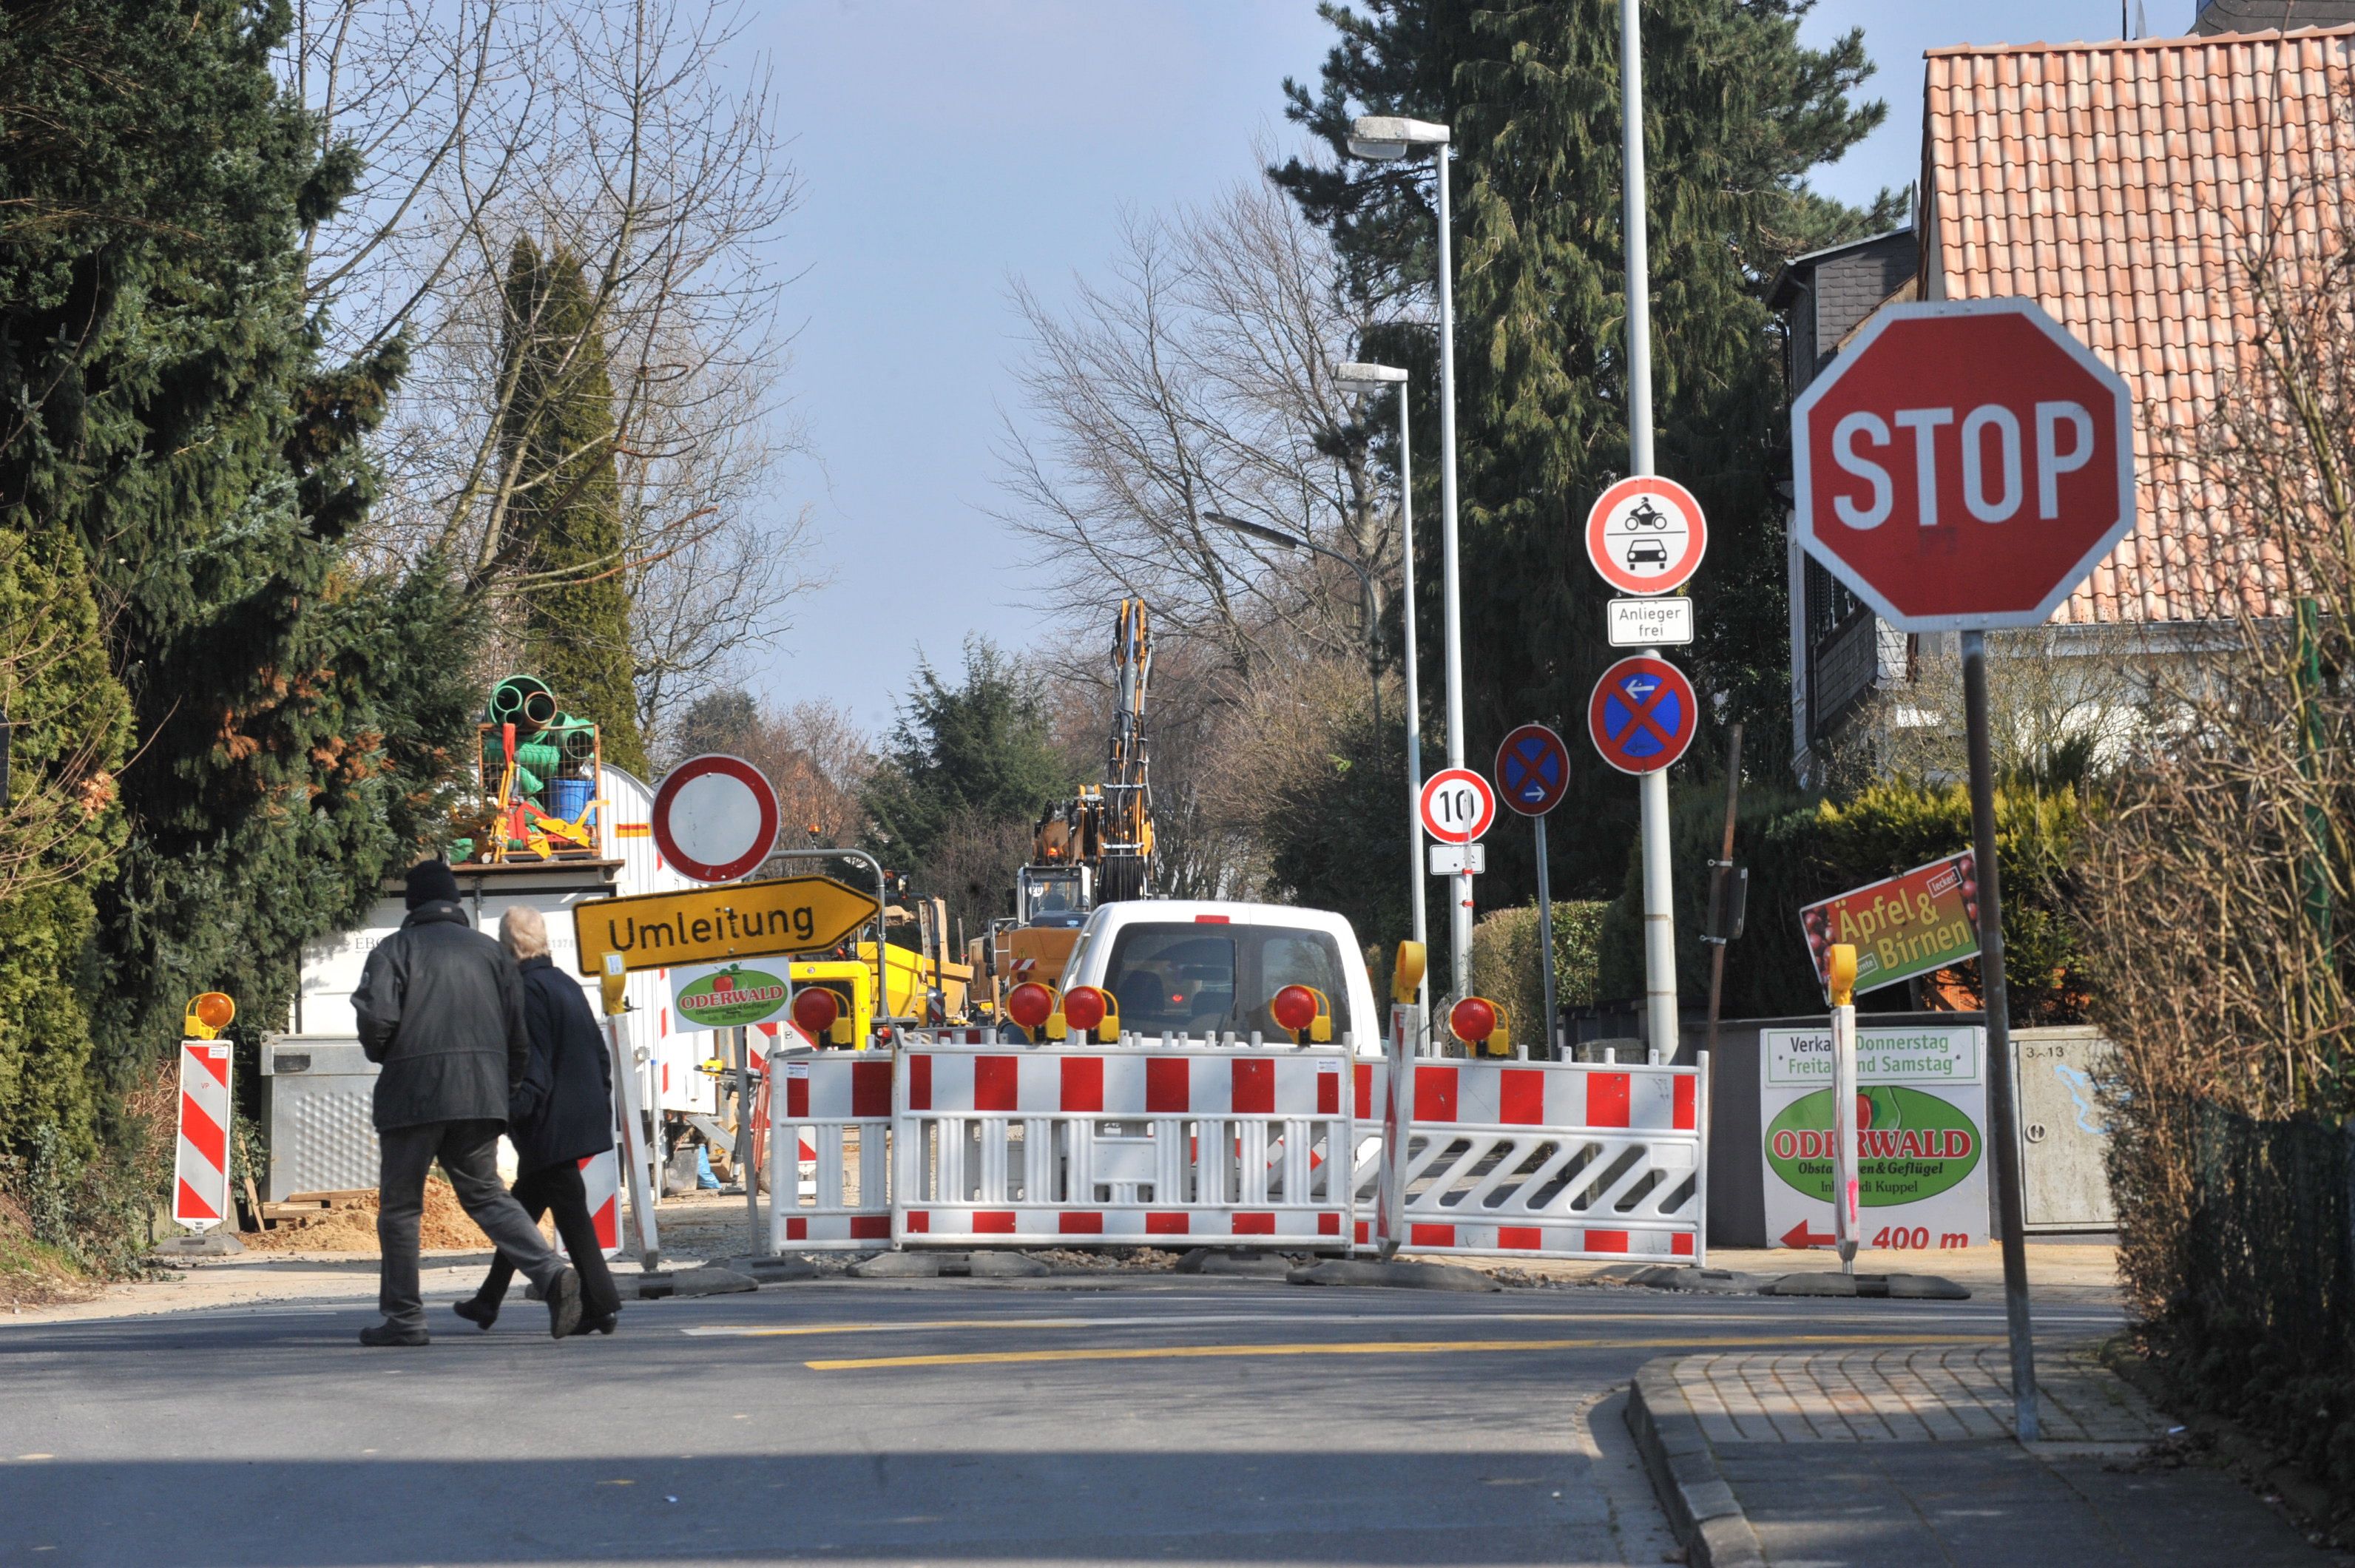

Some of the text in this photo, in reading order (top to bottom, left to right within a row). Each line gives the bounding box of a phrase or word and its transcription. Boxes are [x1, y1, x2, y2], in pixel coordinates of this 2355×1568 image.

[1832, 399, 2094, 530] STOP
[1619, 607, 1681, 622] Anlieger
[1639, 624, 1663, 637] frei
[1439, 789, 1475, 822] 10
[1931, 871, 1958, 892] lecker!
[1834, 888, 1940, 944] Äpfel &
[609, 906, 814, 952] Umleitung
[1876, 919, 1970, 970] Birnen
[680, 985, 784, 1010] ODERWALD
[1856, 1034, 1949, 1054] Donnerstag
[1788, 1055, 1953, 1075] Freita nd Samstag
[1876, 1180, 1918, 1194] Kuppel
[1872, 1226, 1969, 1250] 400 m
